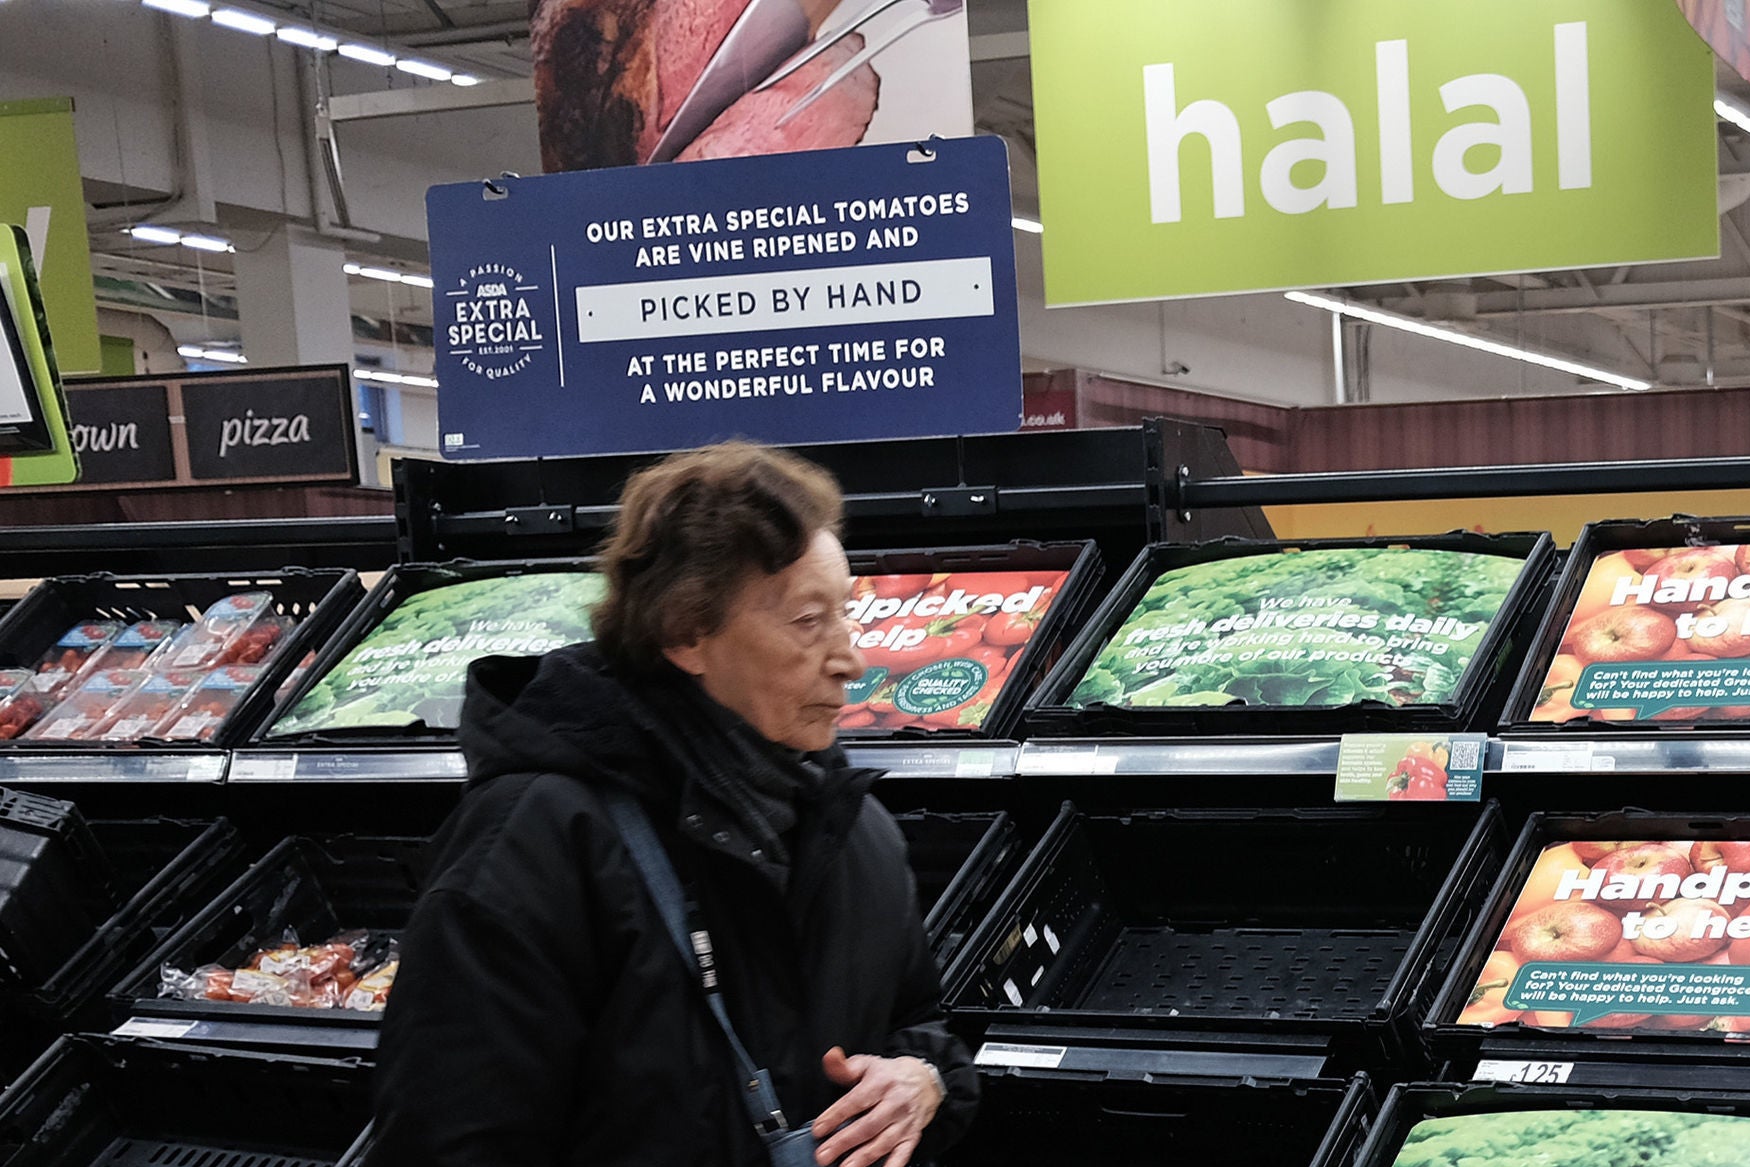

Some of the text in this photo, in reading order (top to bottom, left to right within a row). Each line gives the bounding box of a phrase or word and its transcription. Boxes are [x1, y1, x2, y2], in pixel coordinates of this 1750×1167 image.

[1142, 20, 1592, 224] halal
[586, 192, 970, 243] OUR EXTRA SPECIAL TOMATOES
[635, 226, 919, 267] ARE VINE RIPENED AND
[459, 263, 524, 287] A PASSION
[476, 283, 507, 297] ASDA
[641, 279, 923, 322] PICKED BY HAND
[456, 298, 531, 322] EXTRA
[449, 320, 543, 345] SPECIAL
[461, 353, 532, 379] FOR QUALITY
[627, 337, 945, 377] AT THE PERFECT TIME FOR
[640, 367, 935, 404] A WONDERFUL FLAVOUR
[219, 409, 311, 458] pizza
[845, 586, 1045, 624] dpicked
[1124, 611, 1480, 646] fresh deliveries daily
[1676, 611, 1731, 640] to
[1621, 913, 1681, 942] to
[1524, 980, 1552, 990] for?
[1558, 981, 1590, 991] Your
[1593, 982, 1665, 993] dedicated
[1530, 970, 1744, 986] Can't find what you're looking
[1520, 991, 1739, 1006] will be happy to help. Just ask.
